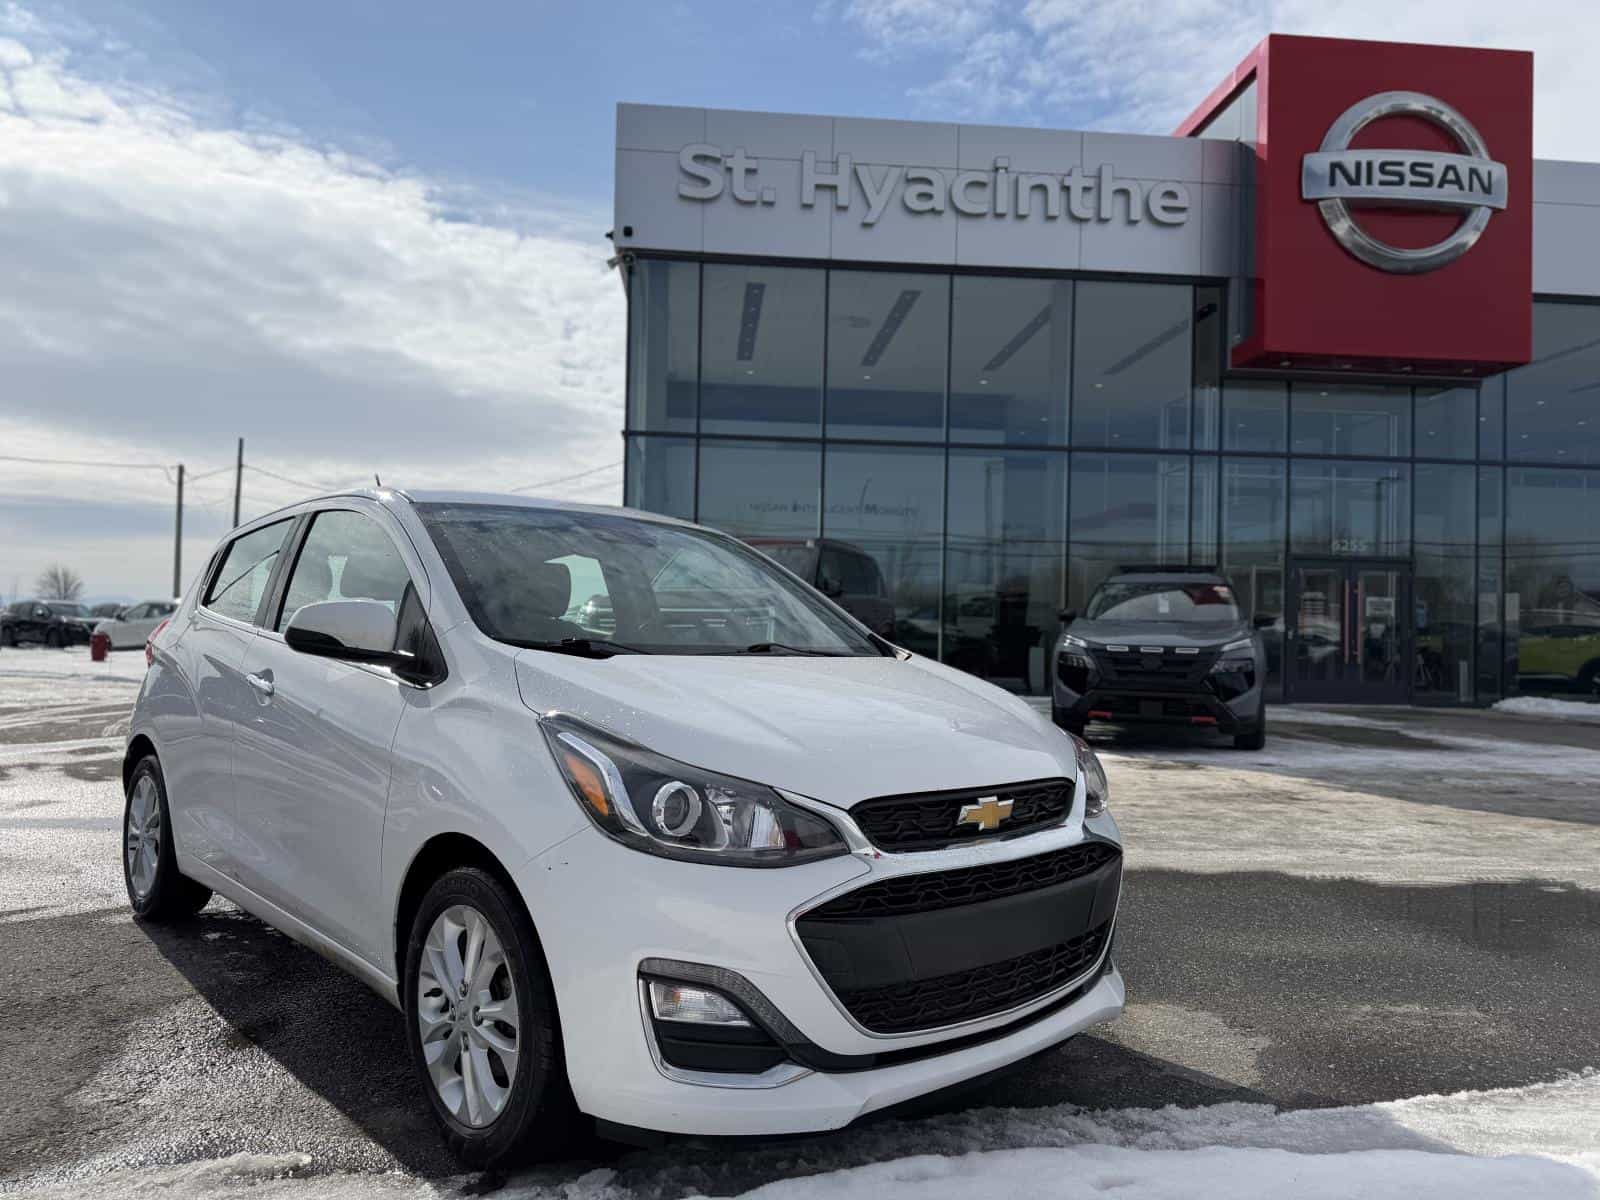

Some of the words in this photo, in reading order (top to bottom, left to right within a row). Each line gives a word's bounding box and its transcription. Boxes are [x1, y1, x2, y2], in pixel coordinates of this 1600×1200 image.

[677, 143, 776, 204] St.
[801, 151, 1190, 226] Hyacinthe
[1328, 160, 1493, 195] NISSAN
